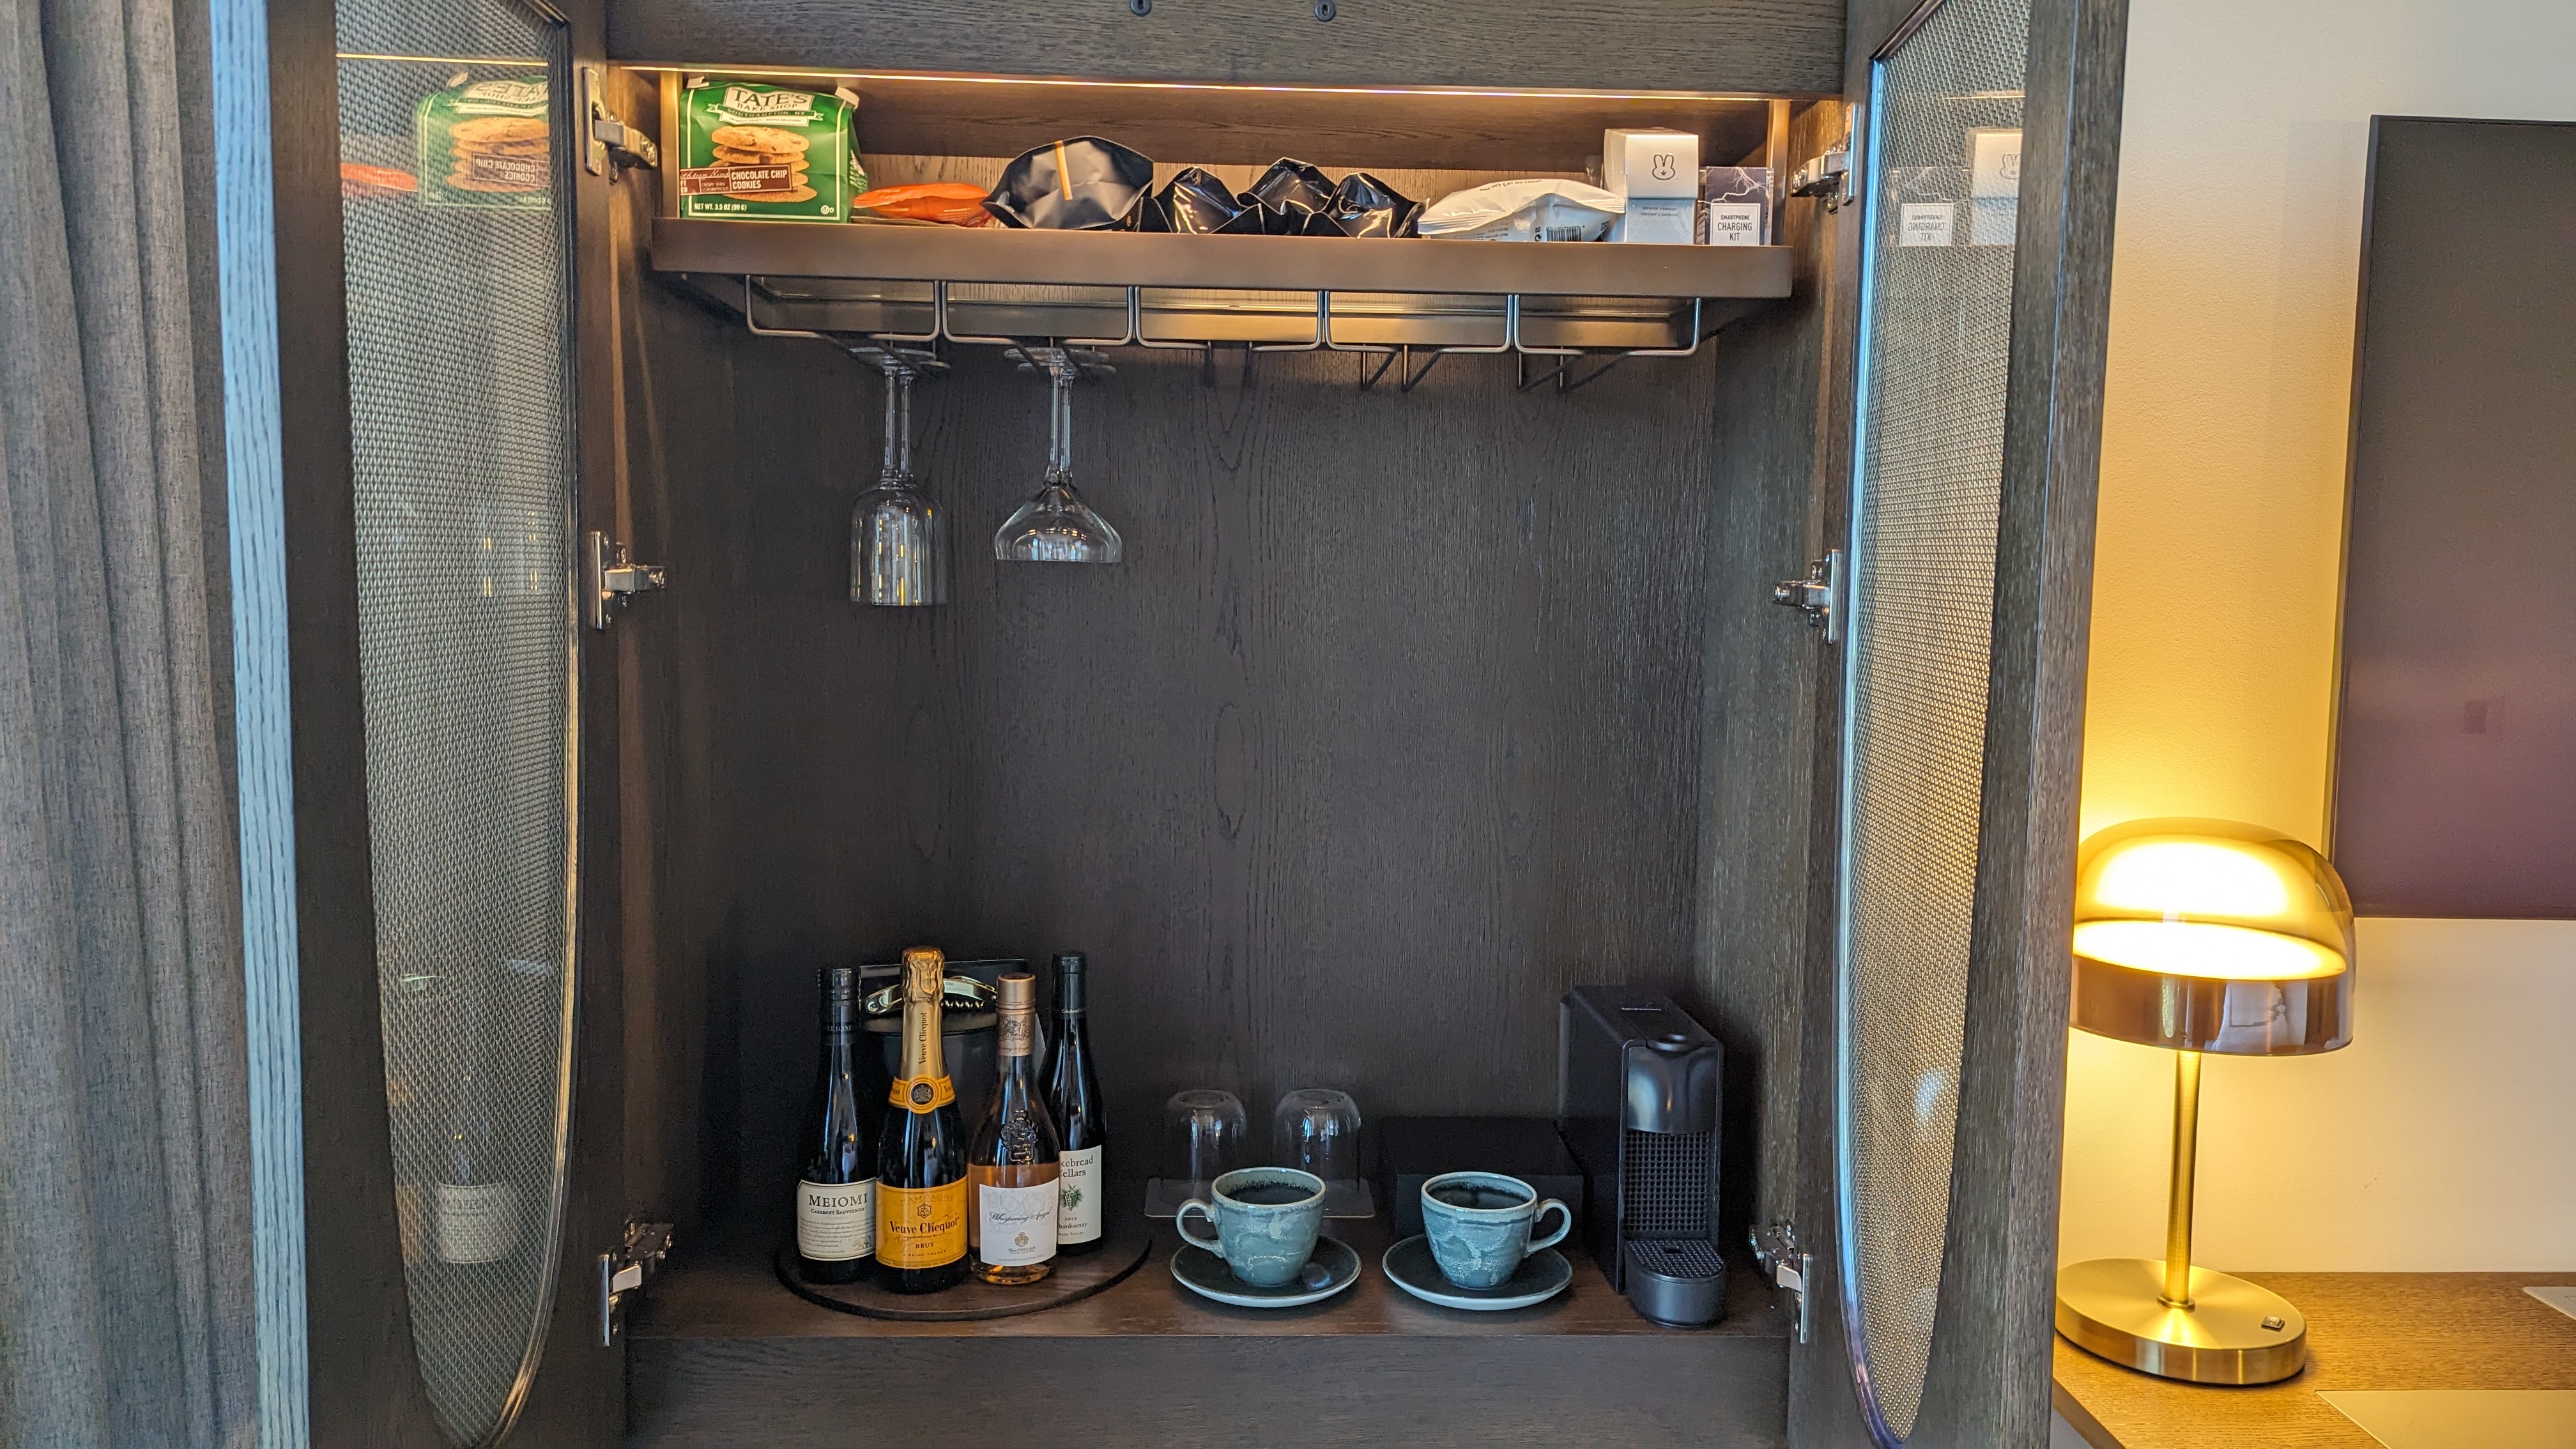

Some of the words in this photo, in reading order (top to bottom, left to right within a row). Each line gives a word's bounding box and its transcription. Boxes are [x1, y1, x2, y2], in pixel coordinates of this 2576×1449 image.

[732, 88, 808, 107] TATE'S
[737, 103, 765, 111] BAKE
[731, 170, 770, 180] CHOCOLATE
[770, 169, 788, 179] CHIP
[732, 180, 762, 190] COOKIES
[1717, 222, 1752, 231] CHARGING
[1729, 233, 1740, 241] KIT
[919, 1012, 929, 1043] Clicquot
[1061, 1155, 1094, 1167] kebread
[1061, 1169, 1087, 1177] ellars
[809, 1193, 868, 1208] MEIOMI
[893, 1193, 955, 1206] CHAMPAGNE
[989, 1211, 1029, 1224] Whispering
[889, 1220, 917, 1234] Veuve
[919, 1216, 958, 1234] Clicquot
